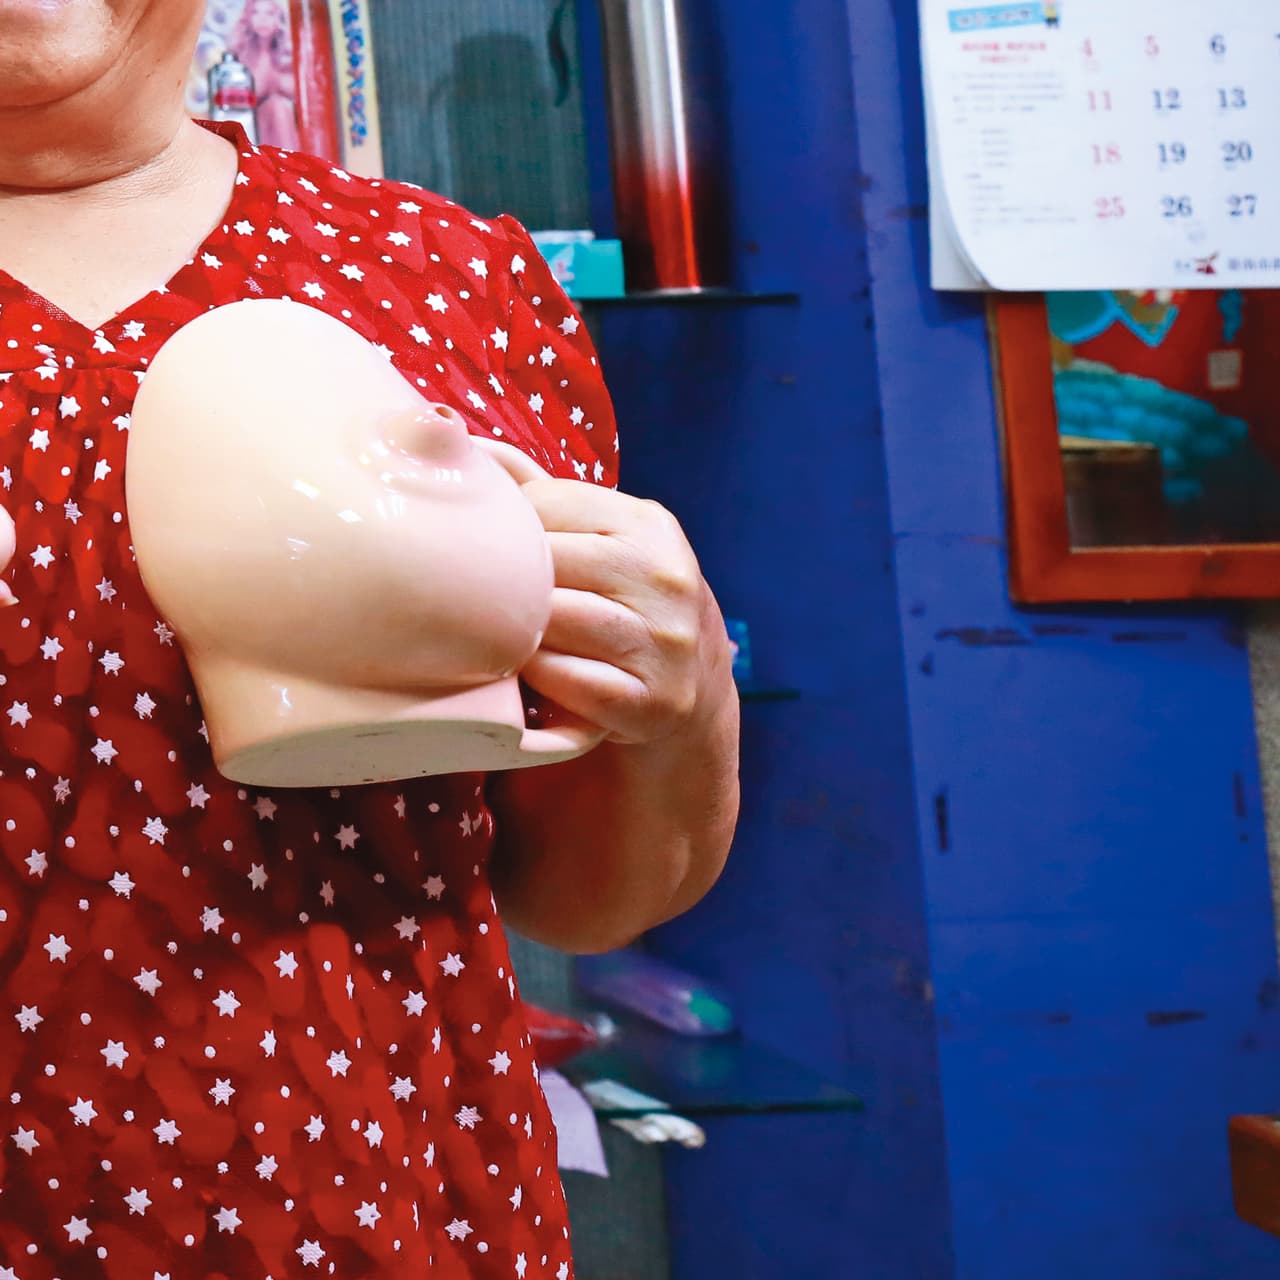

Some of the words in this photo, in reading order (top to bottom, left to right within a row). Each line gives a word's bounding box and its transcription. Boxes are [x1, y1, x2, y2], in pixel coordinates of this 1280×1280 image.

[1145, 35, 1160, 56] 5
[1209, 33, 1226, 55] 6
[1152, 87, 1183, 110] 12
[1217, 86, 1248, 109] 13
[1092, 143, 1121, 164] 18
[1158, 140, 1188, 163] 19
[1220, 140, 1254, 162] 20
[1095, 197, 1126, 219] 25
[1160, 195, 1194, 218] 26
[1225, 194, 1258, 218] 27
